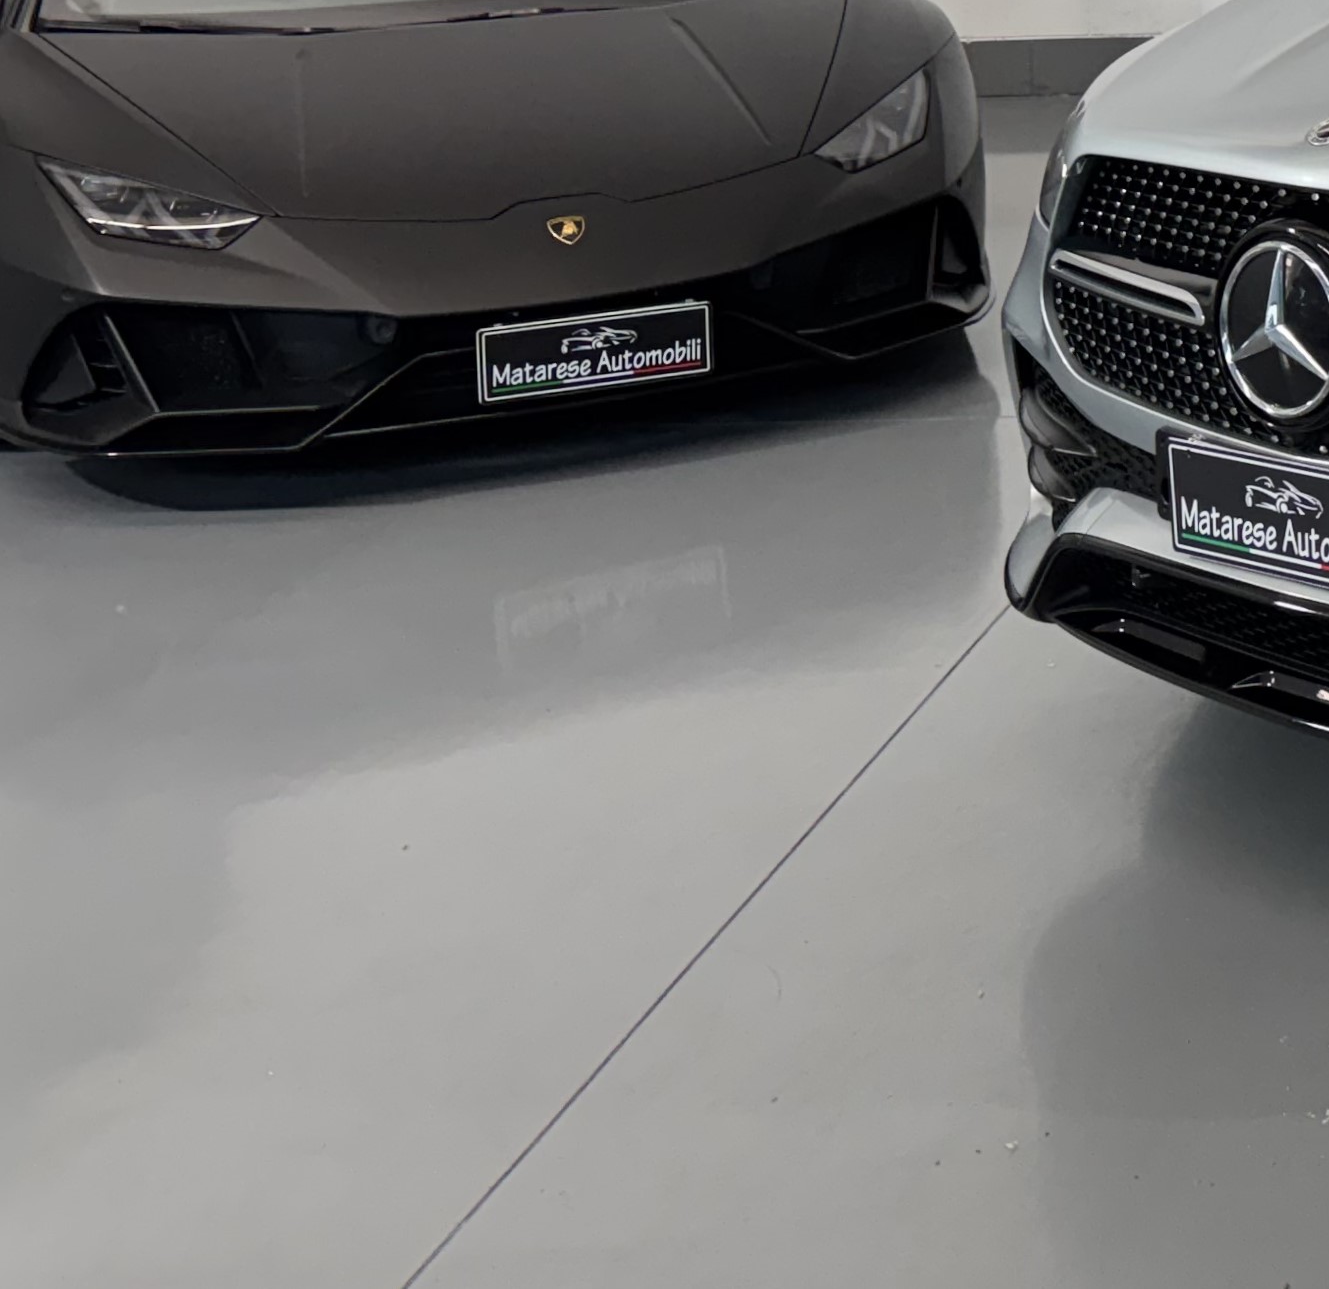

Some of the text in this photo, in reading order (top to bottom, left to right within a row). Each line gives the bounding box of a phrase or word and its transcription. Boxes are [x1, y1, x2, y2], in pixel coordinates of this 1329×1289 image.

[492, 338, 702, 388] Matarese Automobili
[1180, 495, 1278, 551] Matarese
